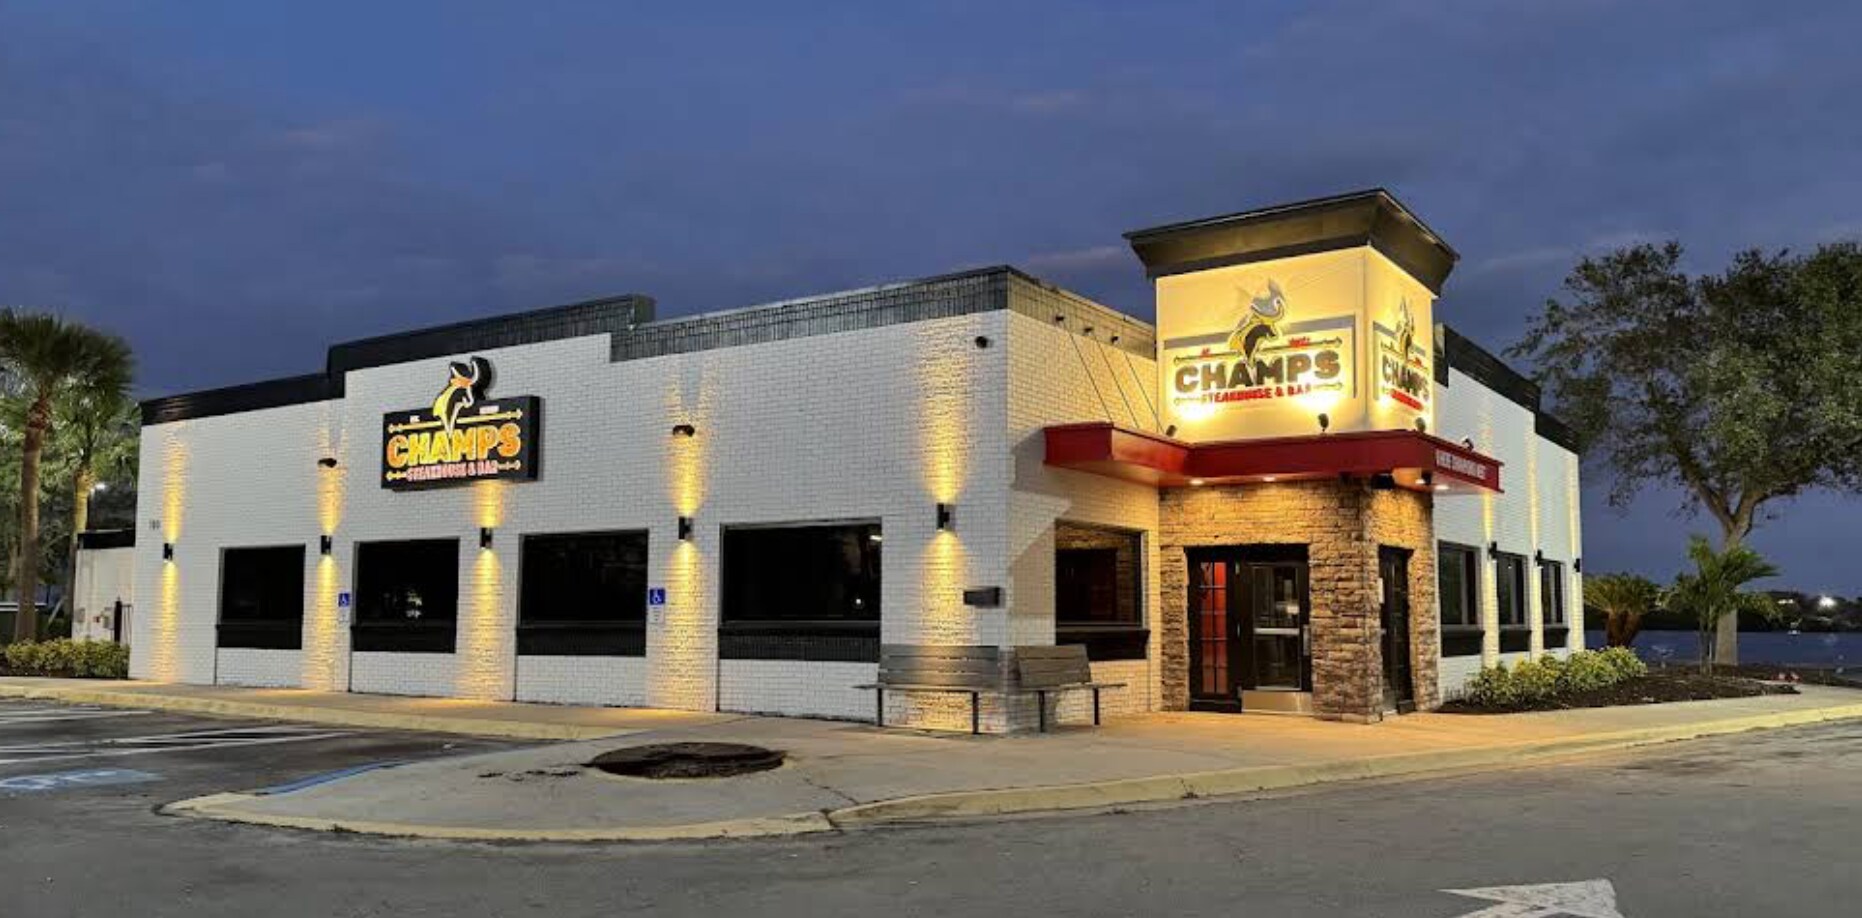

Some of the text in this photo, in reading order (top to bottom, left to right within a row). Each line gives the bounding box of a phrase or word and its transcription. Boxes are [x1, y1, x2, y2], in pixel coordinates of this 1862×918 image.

[1174, 349, 1341, 393] CHAMPS
[1201, 387, 1272, 404] STEAKHOUSE
[1274, 386, 1284, 397] &
[386, 422, 522, 468] CHAMPS
[406, 459, 498, 482] STEAKHOUSE & BAR
